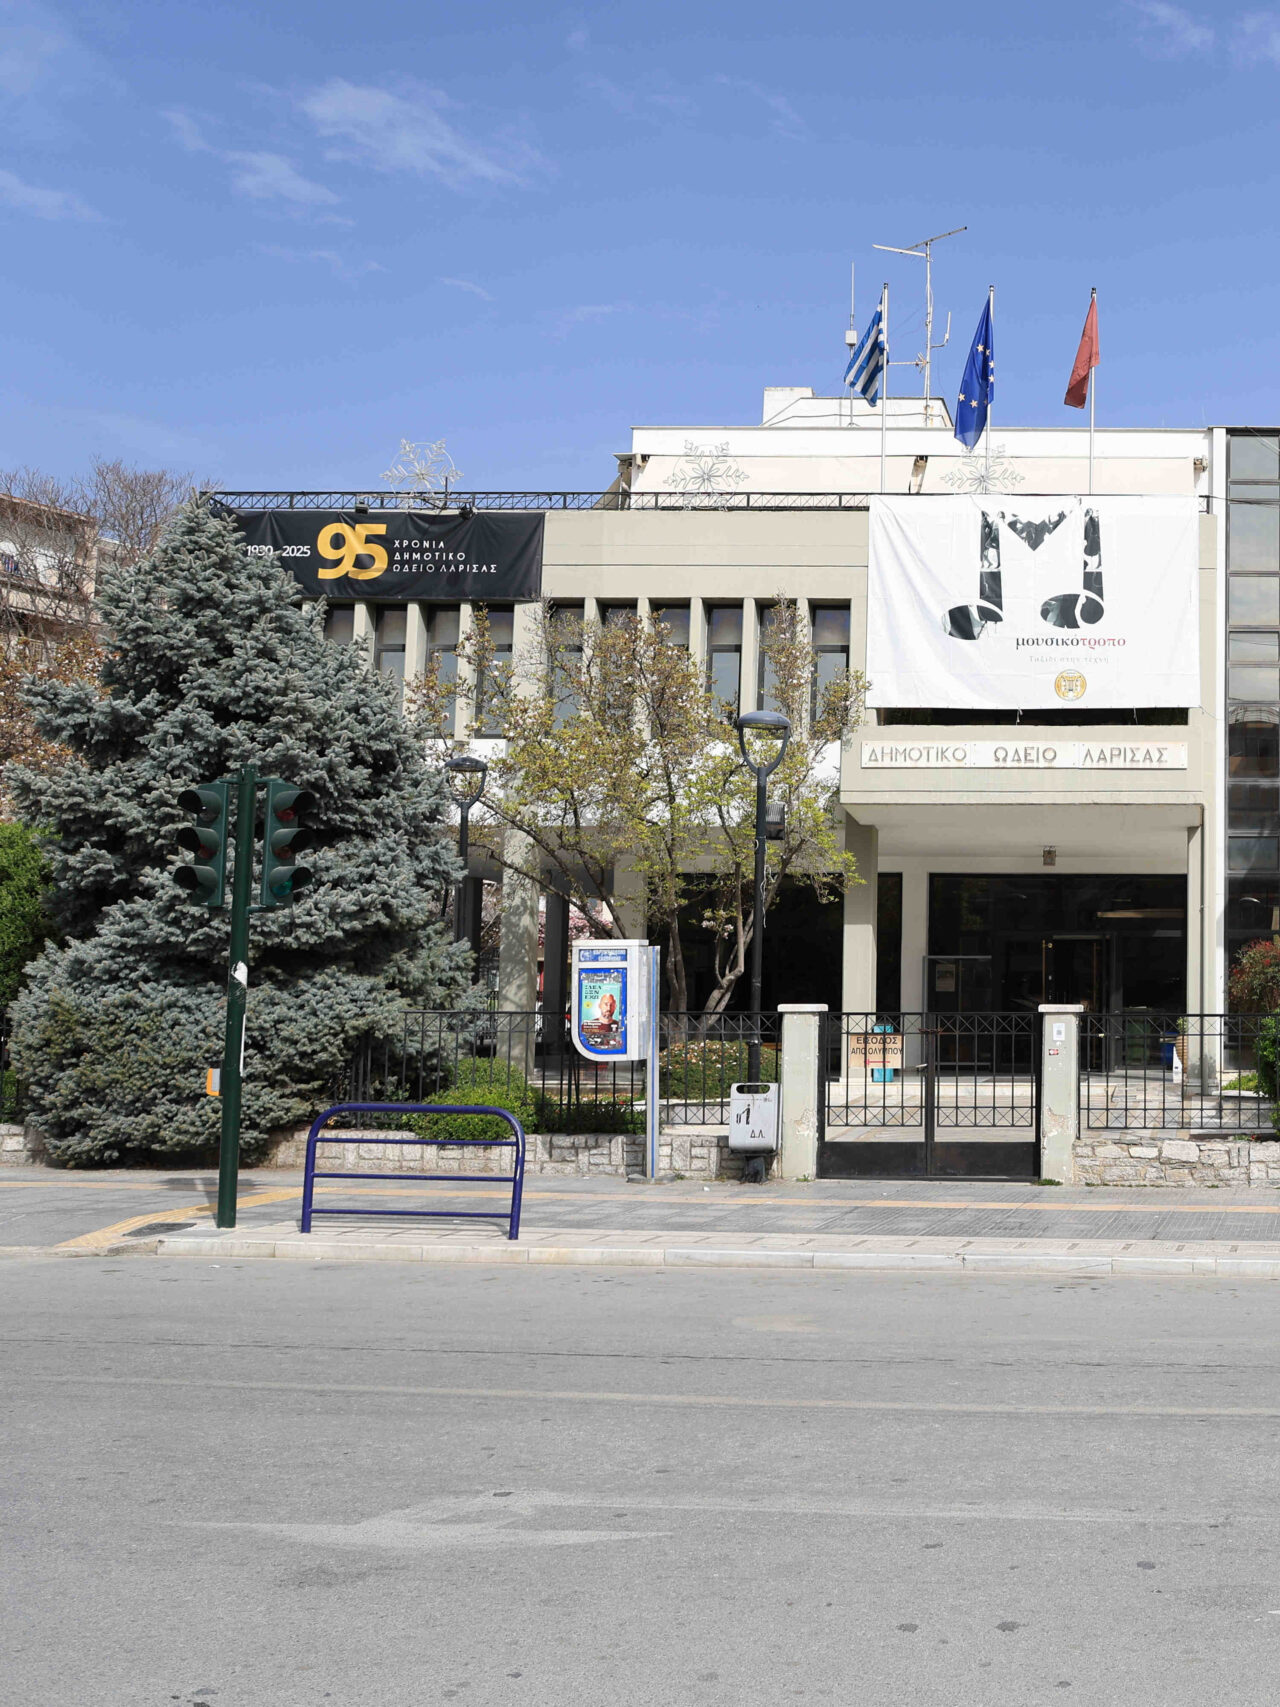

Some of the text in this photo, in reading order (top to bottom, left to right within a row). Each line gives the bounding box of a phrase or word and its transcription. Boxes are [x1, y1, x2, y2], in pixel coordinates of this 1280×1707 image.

[393, 539, 445, 549] ΧΡΟΝΙΑ
[282, 545, 311, 557] 2025
[317, 522, 388, 580] 95
[393, 551, 466, 561] ΔΗΜΟΤΙΚΟ
[392, 563, 497, 573] ΩΔΕΙΟ ΛΑΡΙΣΑΣ
[867, 746, 1168, 764] ΔΗΜΟΤΙΚΟ ΩΔΕΙΟ ΛΑΡΙΣΑΣ
[856, 1036, 898, 1045] ΕΙΣΟΔΟΣ
